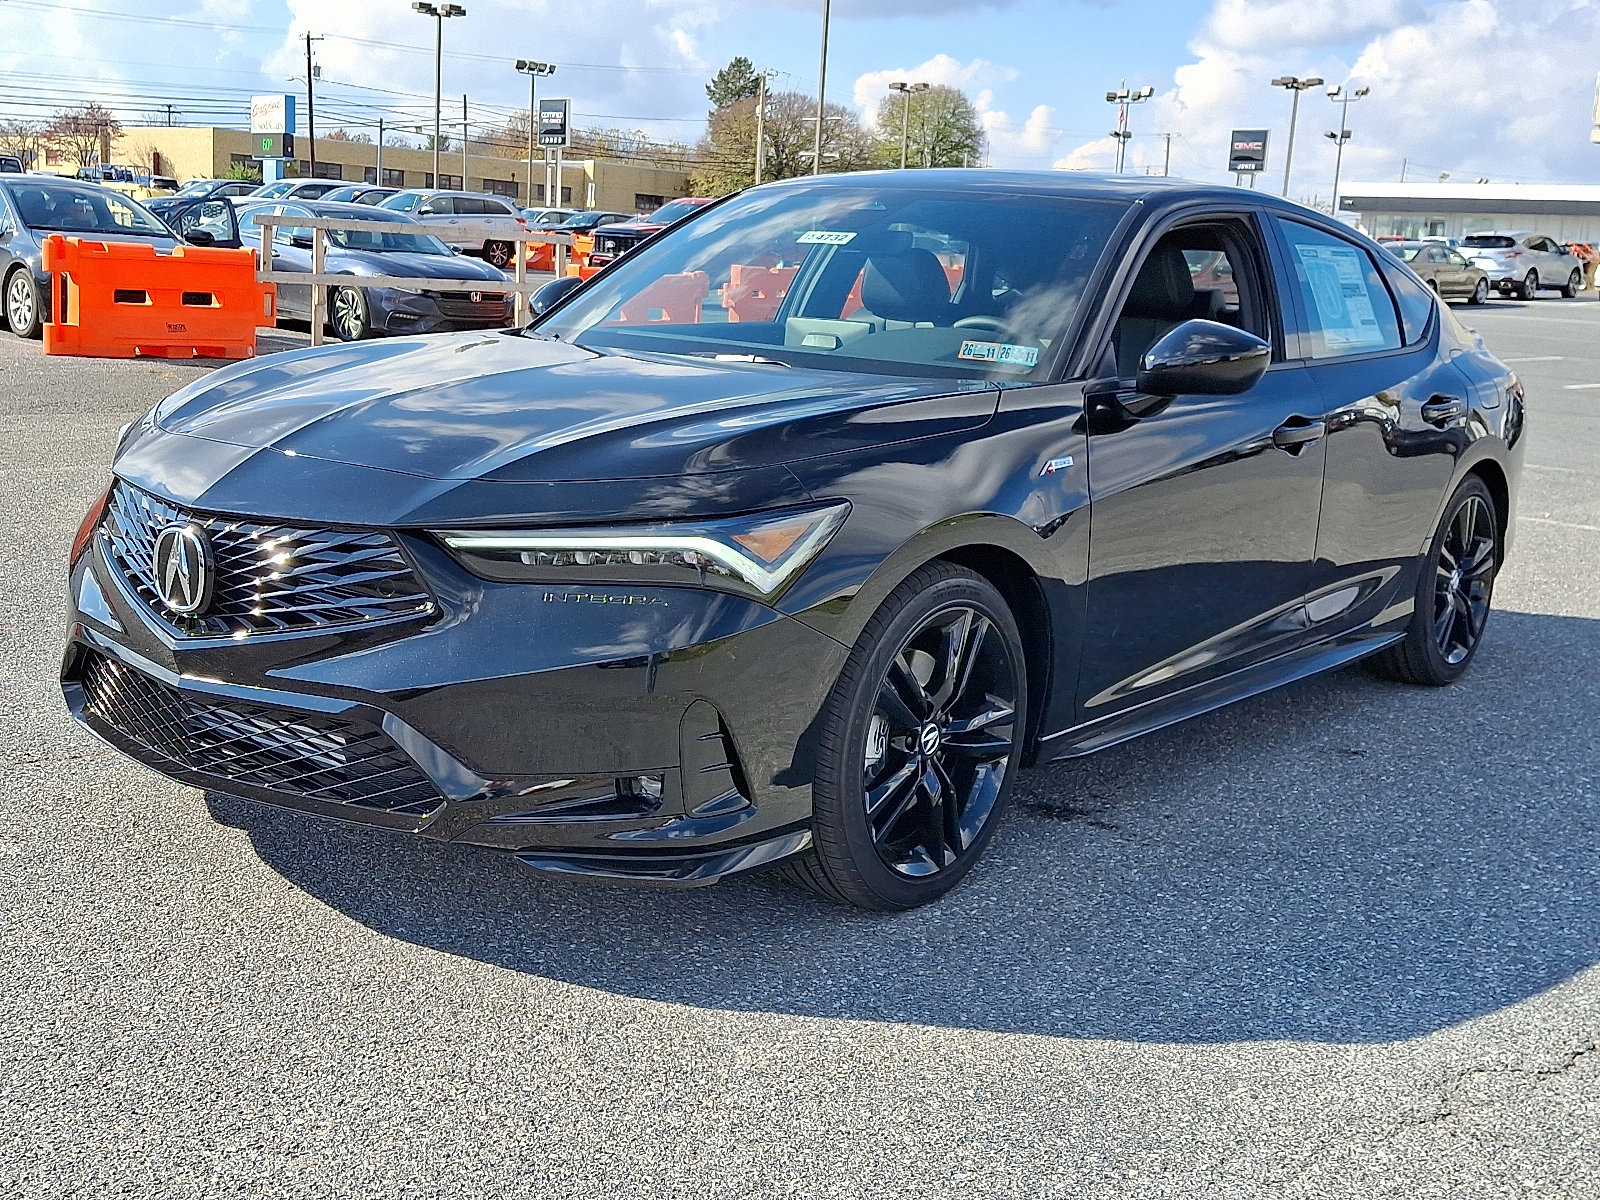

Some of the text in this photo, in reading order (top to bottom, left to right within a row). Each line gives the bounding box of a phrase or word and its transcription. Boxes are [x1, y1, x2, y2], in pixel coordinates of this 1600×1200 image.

[1234, 142, 1263, 150] GMC
[962, 343, 996, 359] 26 11
[1000, 346, 1036, 363] 26 11
[542, 592, 669, 607] INTEGRA
